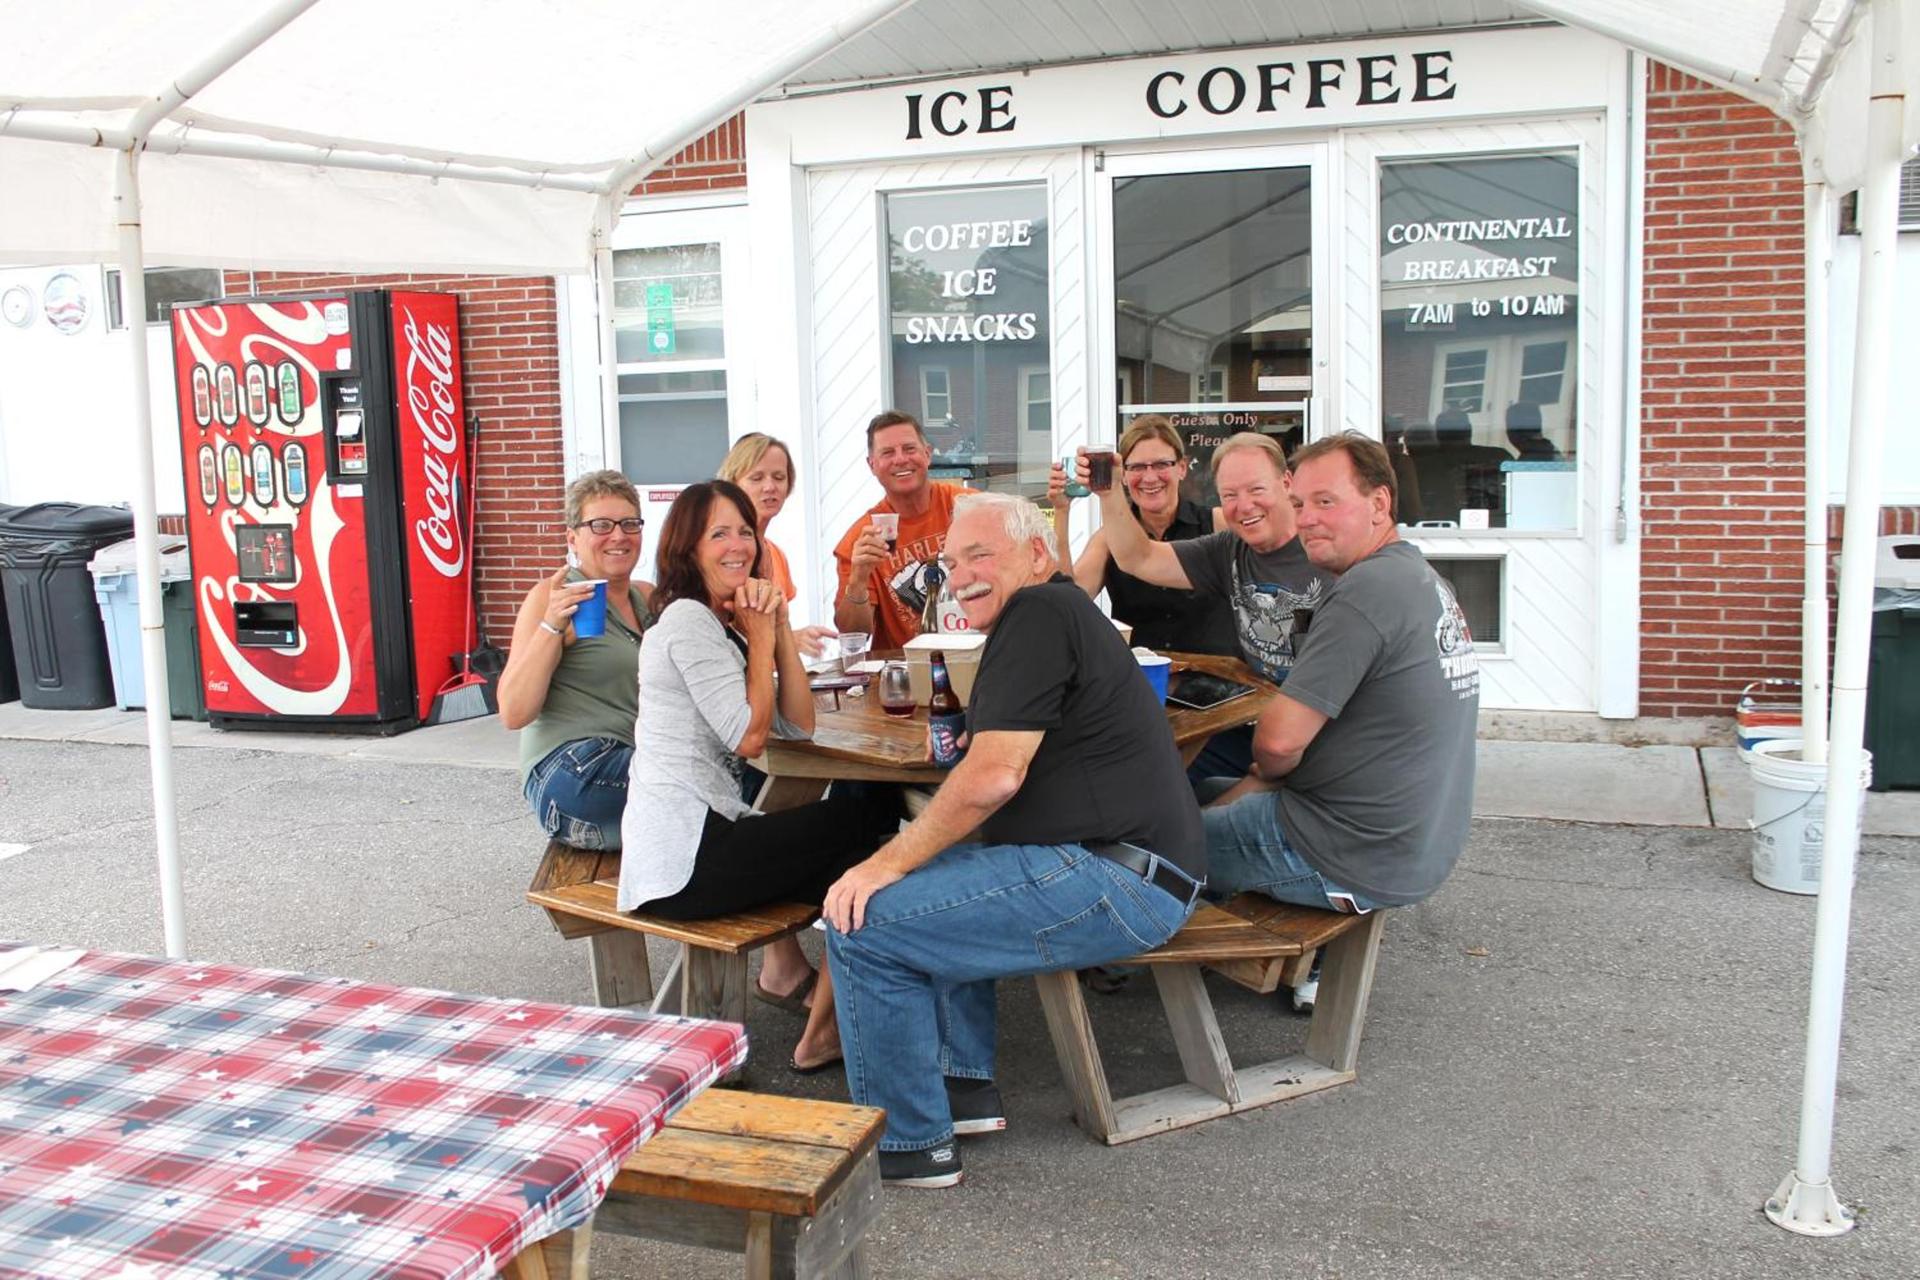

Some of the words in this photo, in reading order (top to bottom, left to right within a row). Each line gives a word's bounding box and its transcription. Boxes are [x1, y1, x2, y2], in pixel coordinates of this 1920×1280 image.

[905, 85, 1017, 140] ICE
[1146, 50, 1457, 118] COFFEE
[903, 219, 1032, 252] COFFEE
[1387, 217, 1572, 244] CONTINENTAL
[942, 267, 997, 297] ICE
[1402, 256, 1557, 281] BREAKFAST
[1408, 303, 1454, 324] 7AM
[1471, 298, 1490, 316] to
[1501, 295, 1528, 316] 10
[1532, 295, 1565, 315] AM
[905, 313, 1037, 344] SNACKS
[339, 387, 359, 395] Thank
[1223, 412, 1259, 428] Only
[403, 304, 465, 578] Coca-Cola
[1189, 434, 1226, 447] Plea
[888, 534, 946, 569] HARLE
[943, 613, 969, 632] Co
[1260, 650, 1295, 667] DAVI
